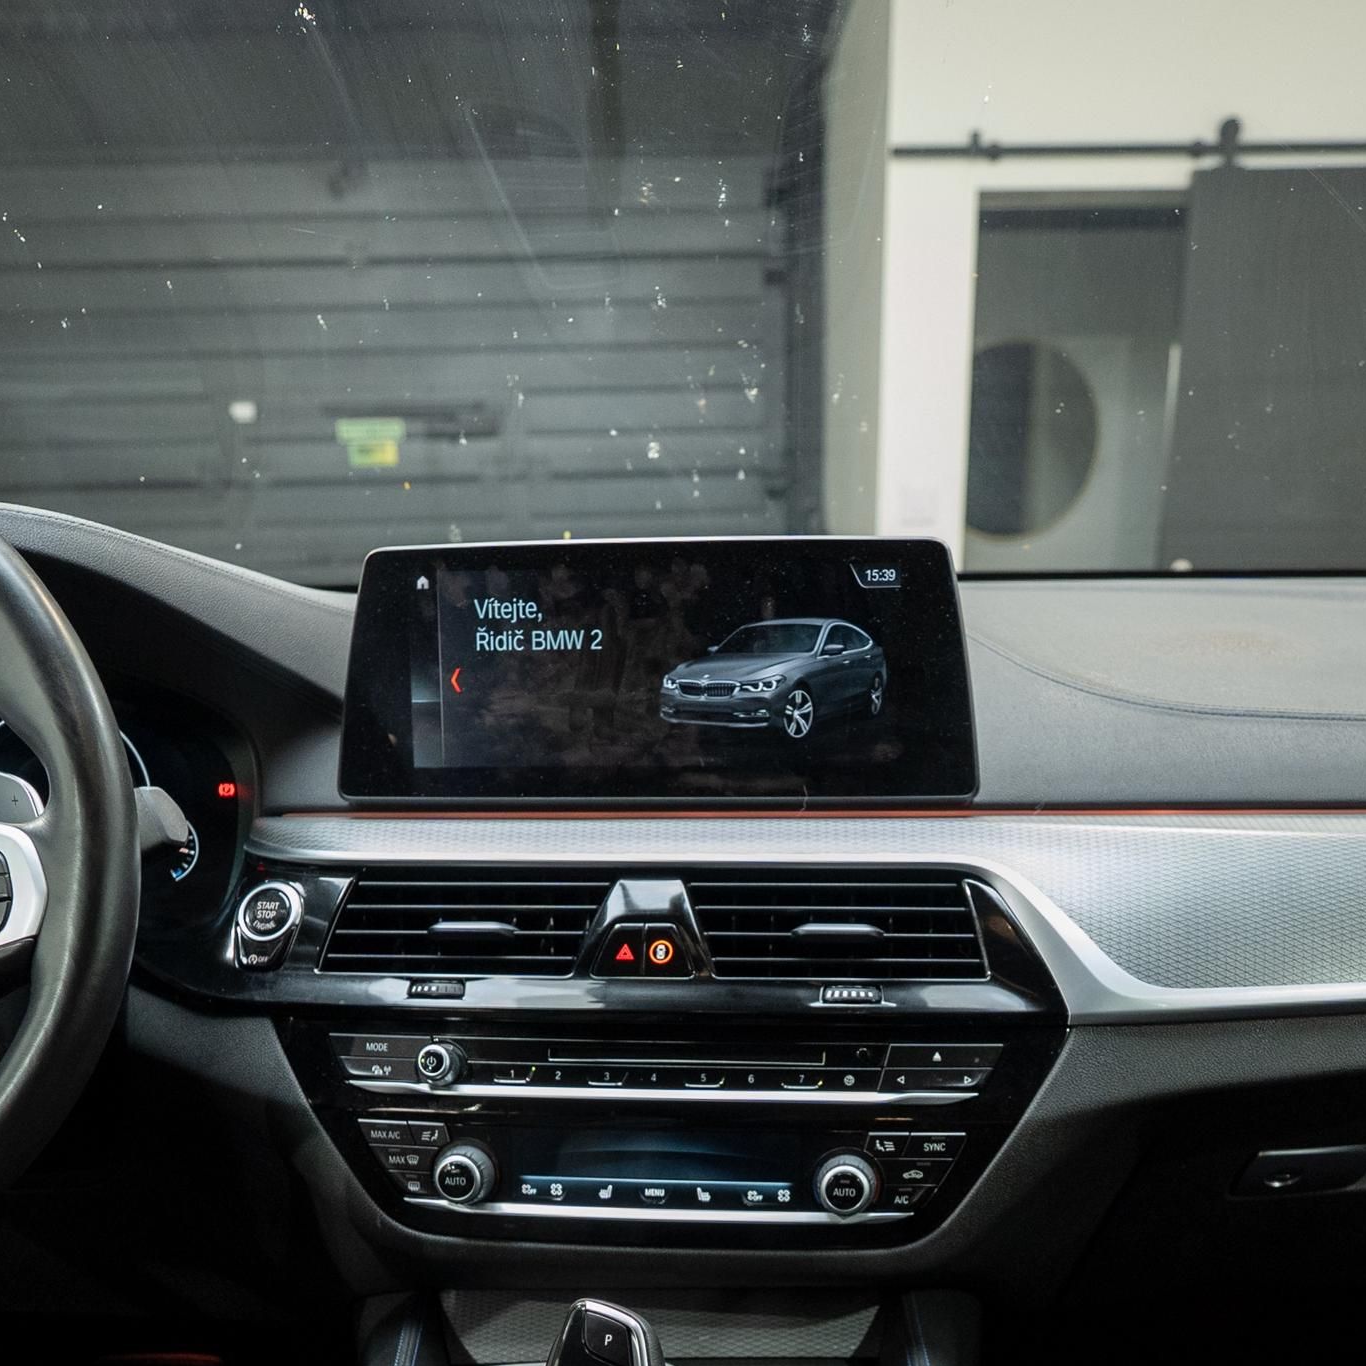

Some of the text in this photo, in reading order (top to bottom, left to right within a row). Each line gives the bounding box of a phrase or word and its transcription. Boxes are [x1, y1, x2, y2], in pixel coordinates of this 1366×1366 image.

[864, 568, 896, 582] 15:39
[474, 597, 543, 623] Vítejte,
[476, 626, 603, 651] Řidič BMW 2
[257, 901, 280, 910] START
[257, 910, 276, 919] STOP
[252, 919, 276, 930] ENGINE
[365, 1042, 389, 1052] MODE
[370, 1129, 401, 1140] MAX A/C
[923, 1142, 947, 1153] SYNC
[388, 1154, 406, 1165] MAX
[444, 1176, 467, 1187] AUTO
[644, 1186, 666, 1198] MENU
[833, 1187, 856, 1198] AUTO
[893, 1195, 910, 1205] A/C
[604, 1334, 613, 1346] P
